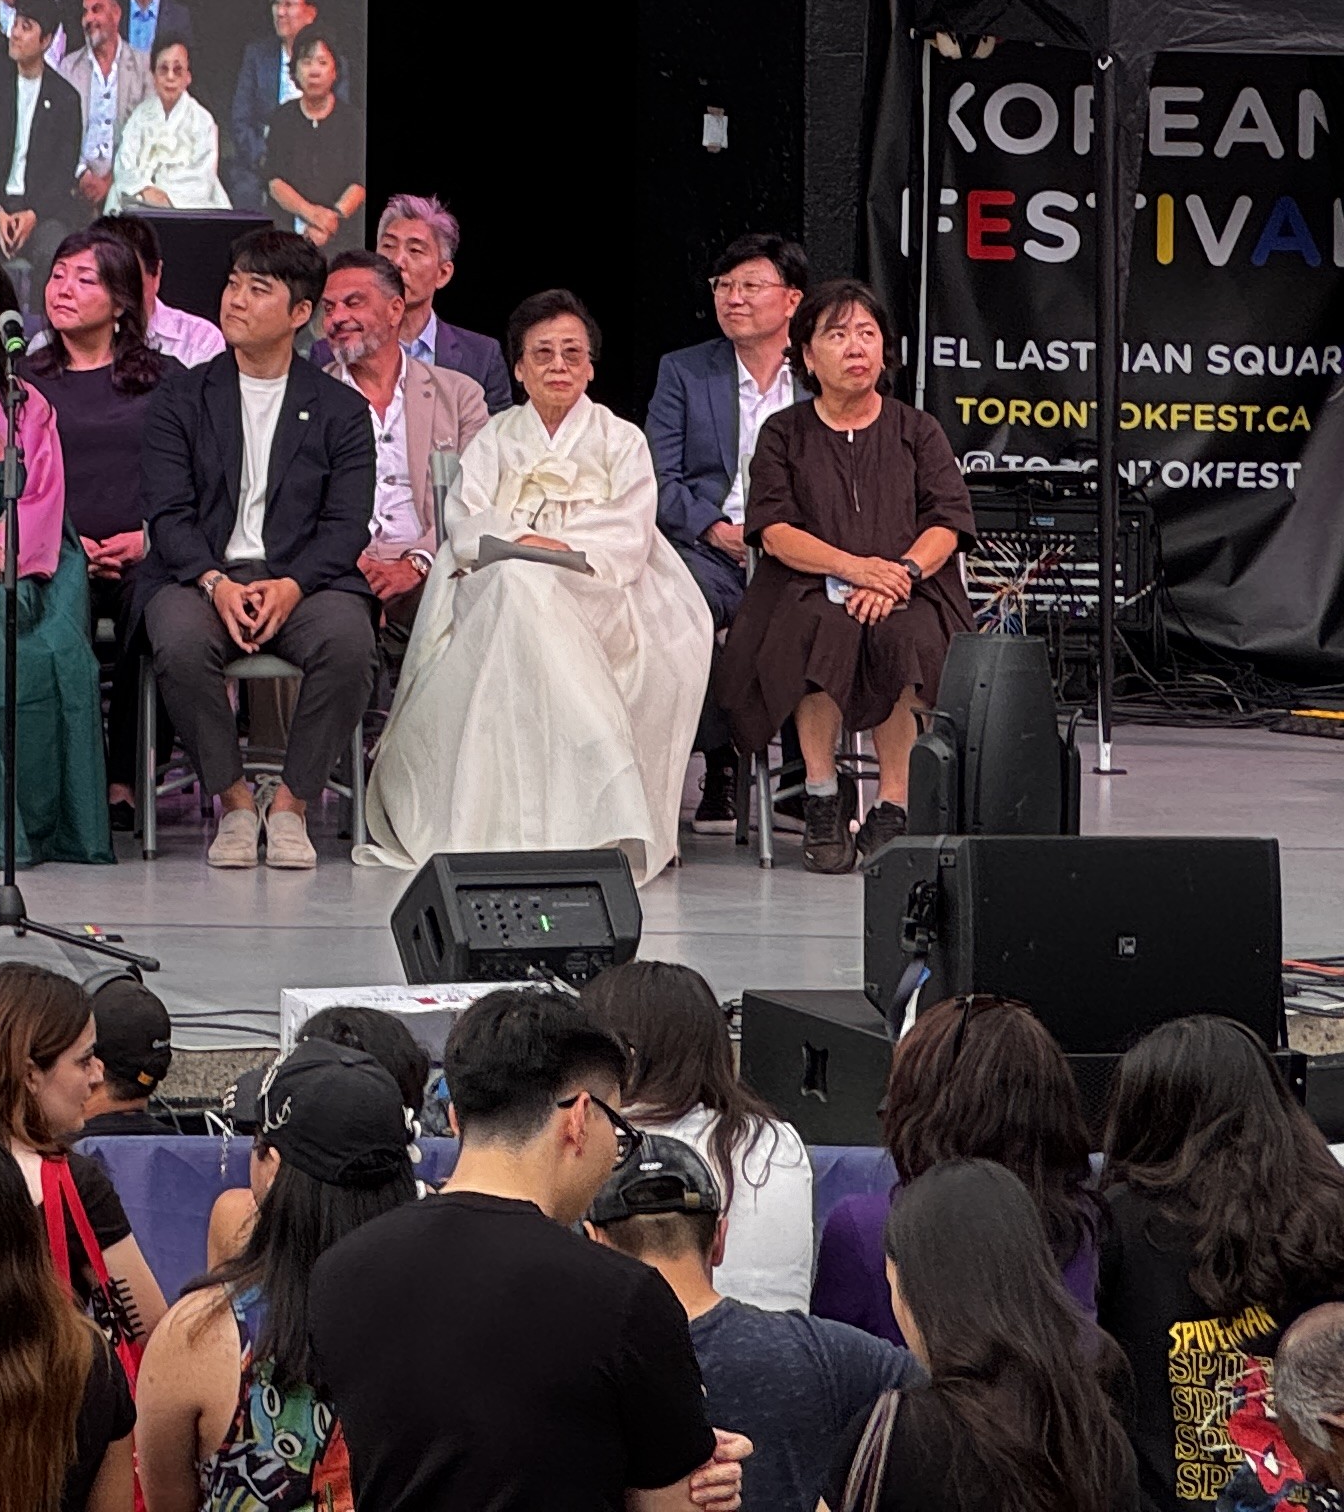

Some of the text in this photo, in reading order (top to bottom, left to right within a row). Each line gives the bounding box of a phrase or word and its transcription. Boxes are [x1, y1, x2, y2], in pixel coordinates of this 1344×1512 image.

[901, 335, 1343, 377] EL LASTAN SQUAR
[955, 396, 1311, 433] TORONOKFEST.CA
